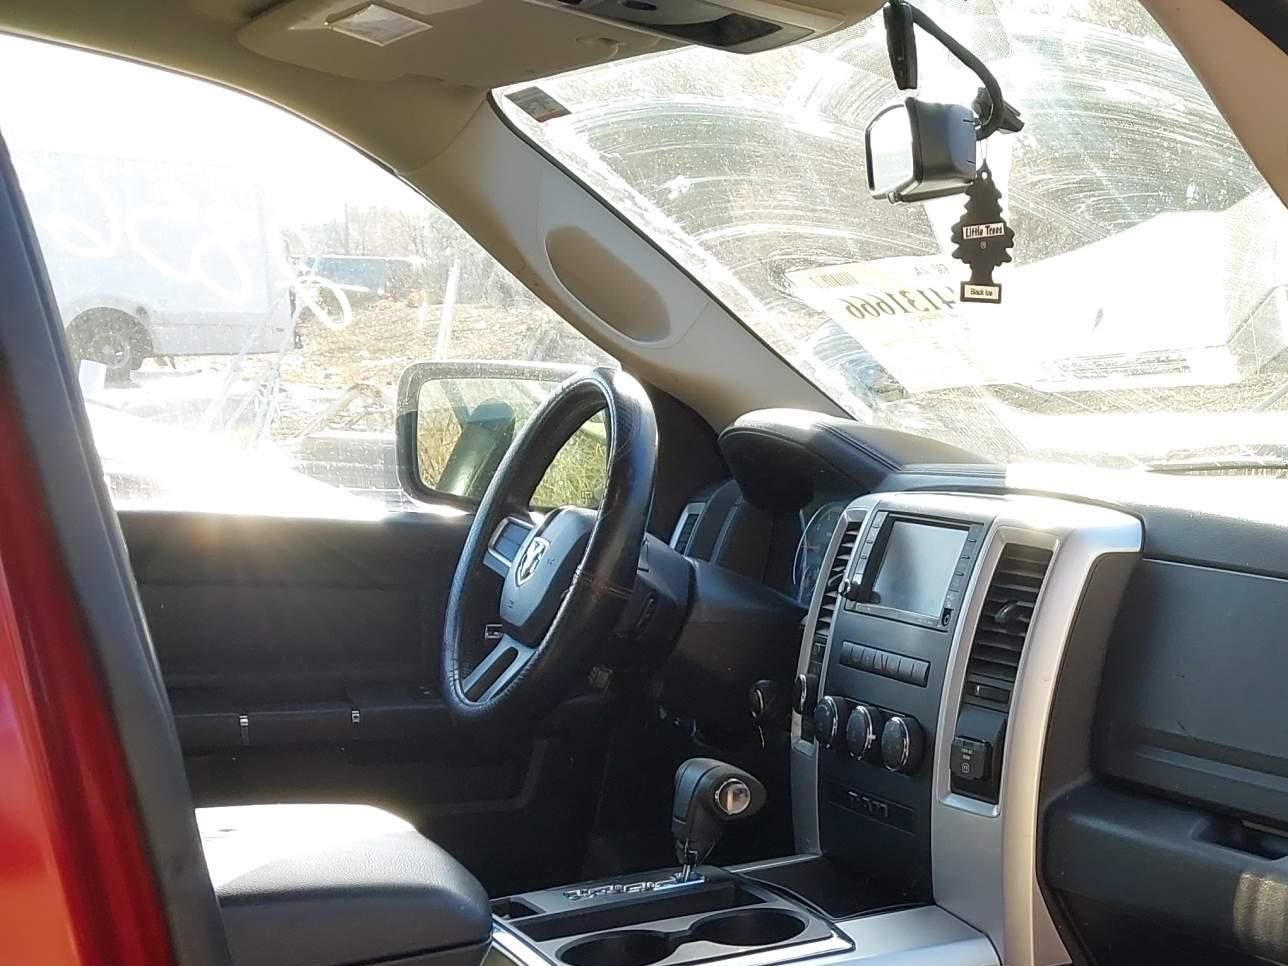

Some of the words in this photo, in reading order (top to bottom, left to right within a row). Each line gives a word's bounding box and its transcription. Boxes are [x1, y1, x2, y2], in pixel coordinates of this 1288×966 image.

[965, 225, 984, 238] Little
[985, 223, 1003, 236] Trees
[970, 287, 984, 296] Black
[985, 289, 993, 297] Ice
